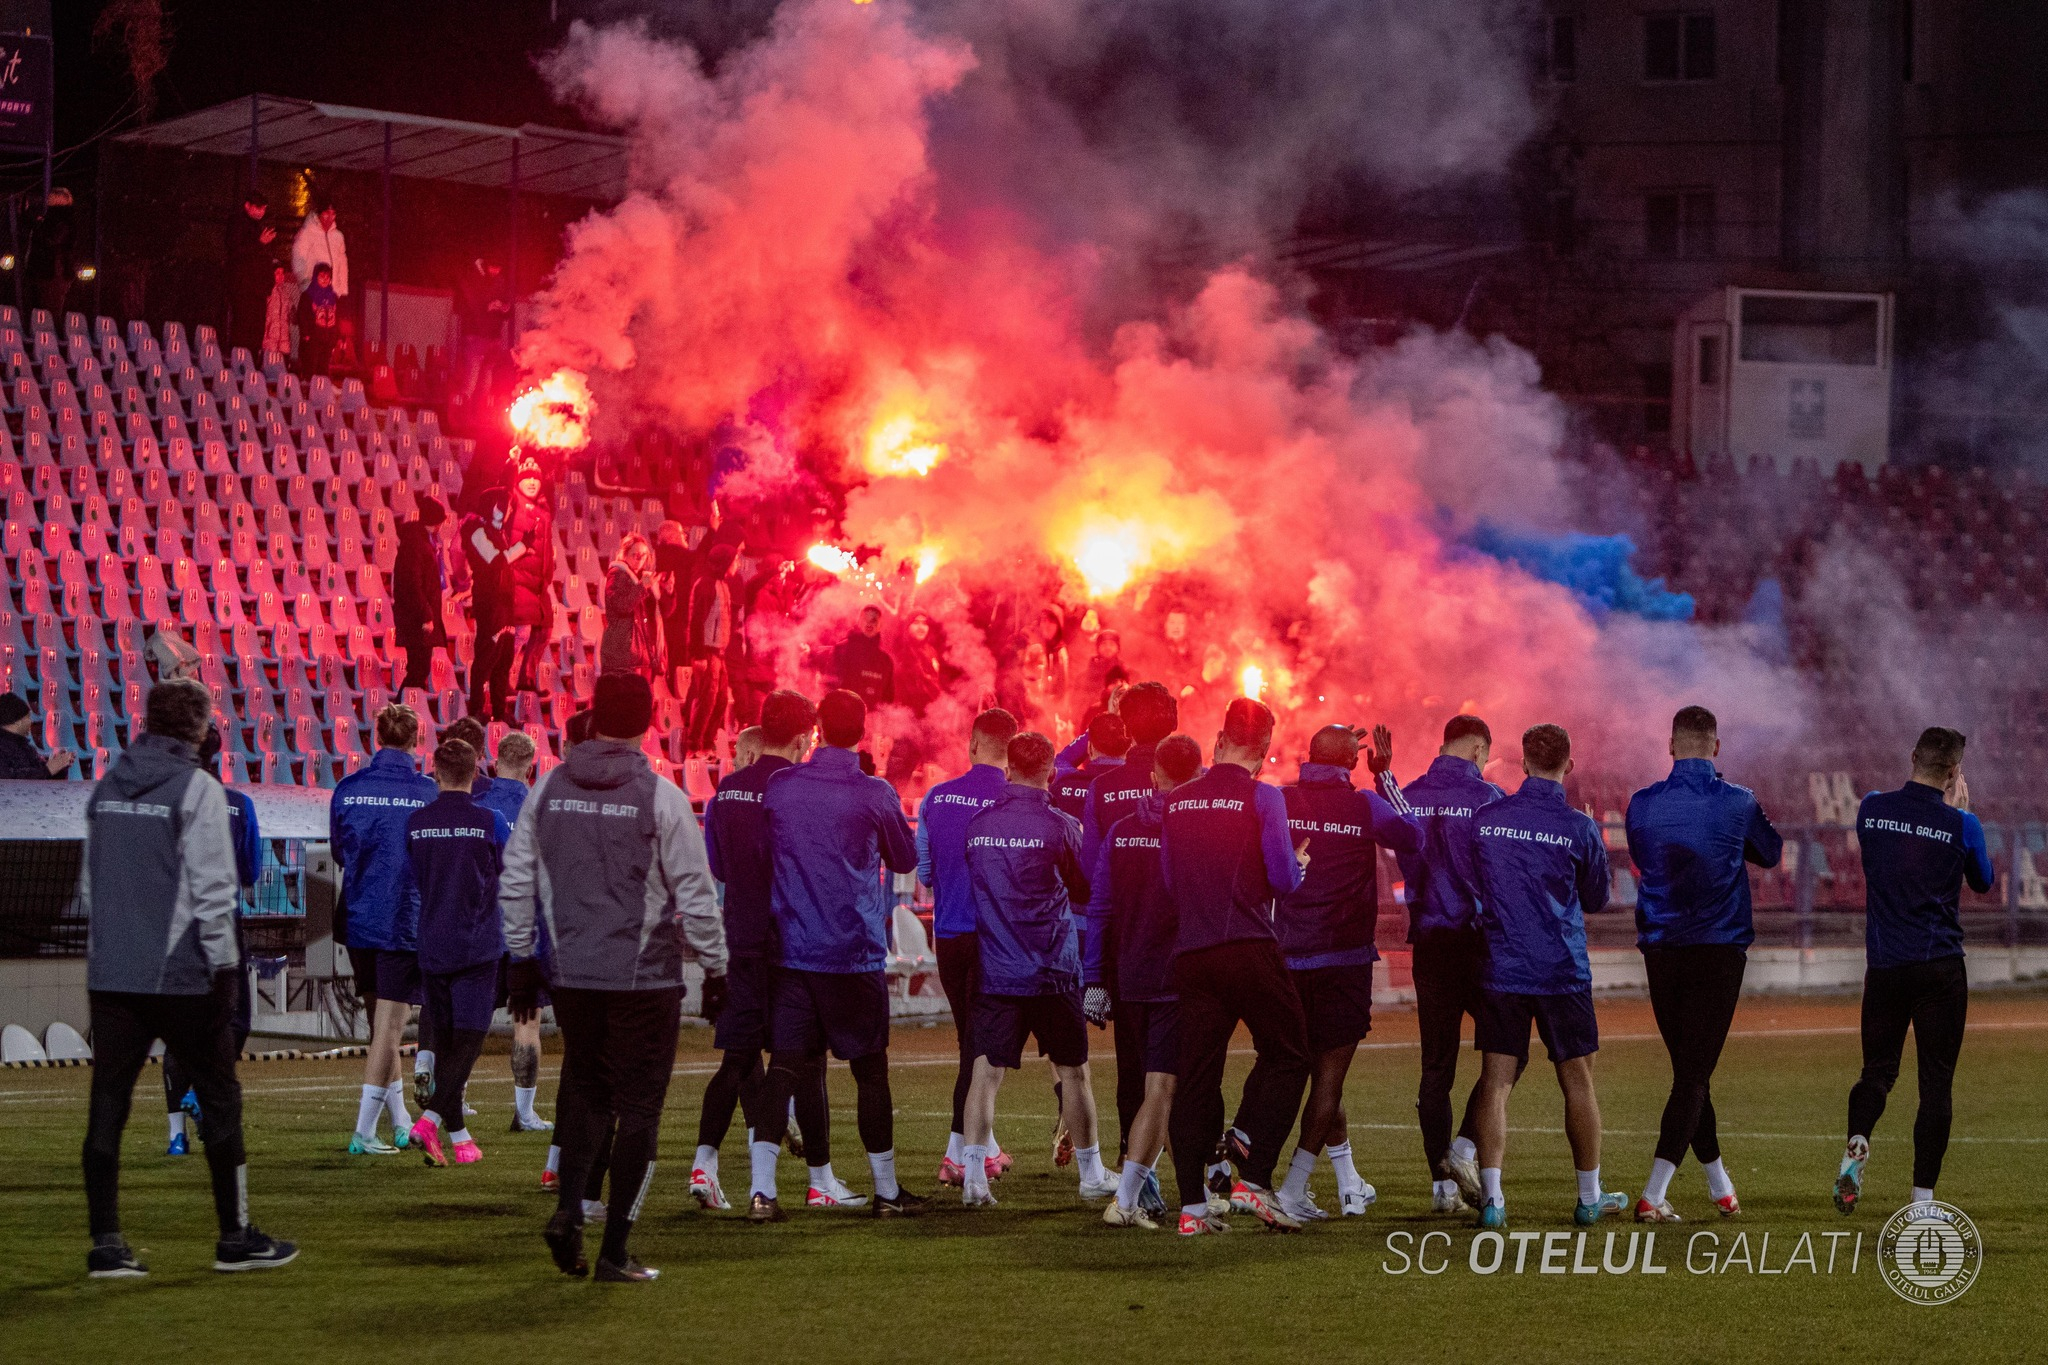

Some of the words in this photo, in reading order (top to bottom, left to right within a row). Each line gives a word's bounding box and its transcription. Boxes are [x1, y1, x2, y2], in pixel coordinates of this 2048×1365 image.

[717, 791, 725, 801] SC
[726, 790, 754, 801] OTELUL
[1061, 787, 1072, 796] SC
[1104, 792, 1115, 803] SC
[344, 796, 355, 806] SC
[356, 796, 391, 806] OTELUL
[393, 797, 425, 808] GALATI
[934, 794, 944, 804] SC
[945, 794, 979, 807] OTELUL
[1178, 799, 1210, 811] OTELUL
[1212, 798, 1244, 811] GALATI
[549, 799, 561, 811] SC
[563, 799, 600, 813] OTELUL
[602, 803, 638, 818] GALATI
[1438, 806, 1472, 818] GALATI
[411, 830, 421, 840] SC
[422, 828, 453, 838] OTELUL
[455, 827, 485, 839] GALATI
[1324, 822, 1361, 836] GALATI
[1865, 818, 1875, 828] SC
[1877, 819, 1912, 834] OTELUL
[1916, 825, 1952, 843] GALATI
[974, 836, 1008, 847] OTELUL
[1010, 838, 1044, 848] GALATI
[1115, 837, 1127, 848] SC
[1129, 837, 1161, 849] OTELUL
[1479, 826, 1491, 835] SC
[1494, 826, 1532, 841] OTELUL
[1535, 832, 1573, 848] GALATI
